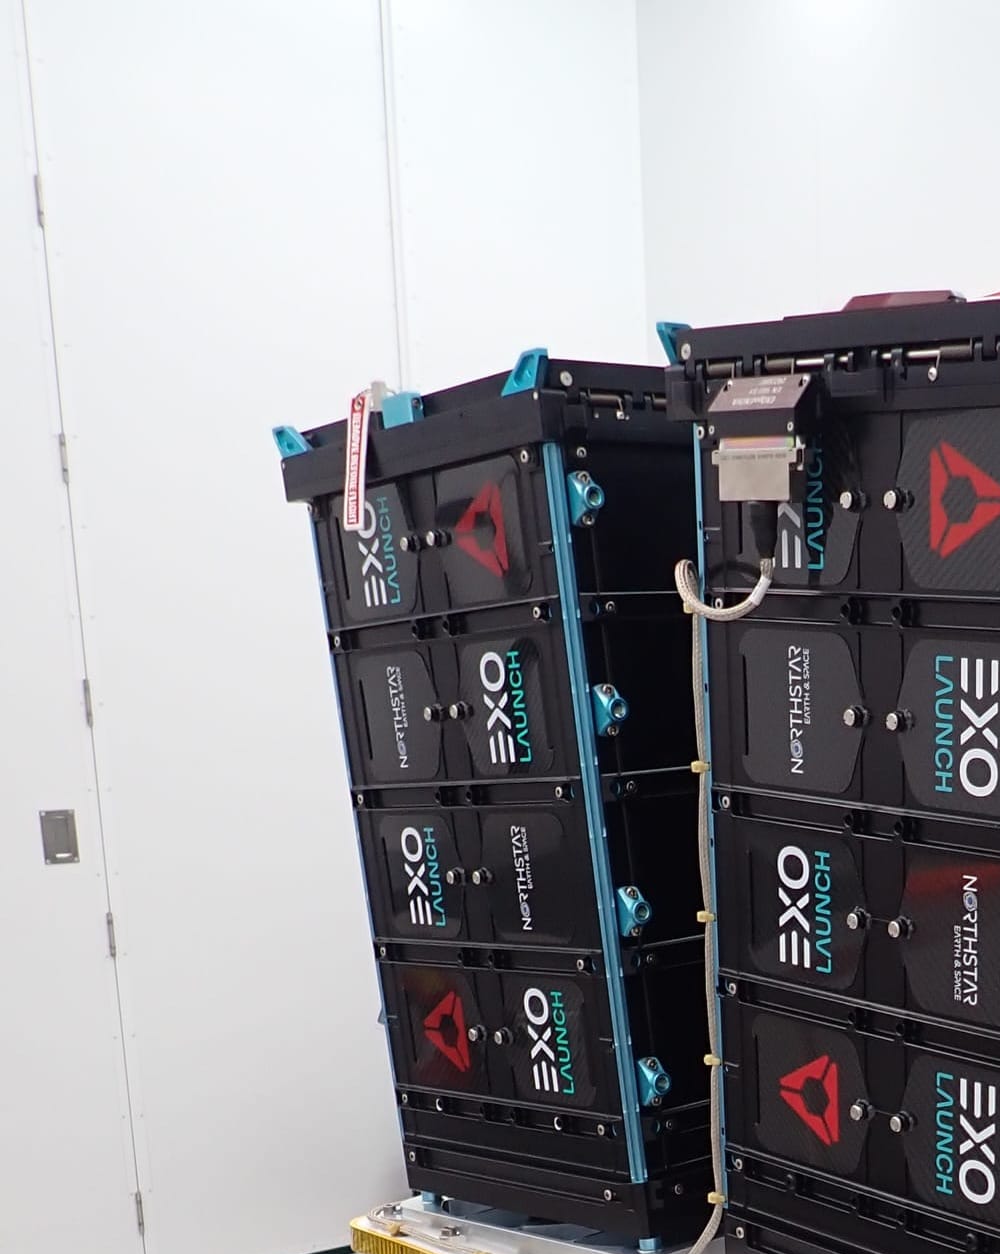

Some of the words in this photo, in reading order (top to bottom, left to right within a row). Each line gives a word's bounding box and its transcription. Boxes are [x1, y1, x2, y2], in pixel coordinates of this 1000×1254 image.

[378, 496, 401, 604] LAUNCH
[480, 652, 516, 764] EXO
[506, 651, 532, 763] LAUNCH
[788, 645, 804, 774] NORTHSTAR
[934, 655, 955, 793] LAUNCH
[960, 658, 999, 797] EXO
[401, 827, 433, 926] EXO
[423, 827, 446, 927] LAUNCH
[777, 845, 811, 969] EXO
[814, 850, 832, 974] LAUNCH
[962, 874, 978, 1006] NORTHSTAR
[524, 987, 559, 1093] EXO
[550, 990, 575, 1096] LAUNCH
[935, 1072, 954, 1196] LAUNCH
[959, 1078, 996, 1204] EXO
